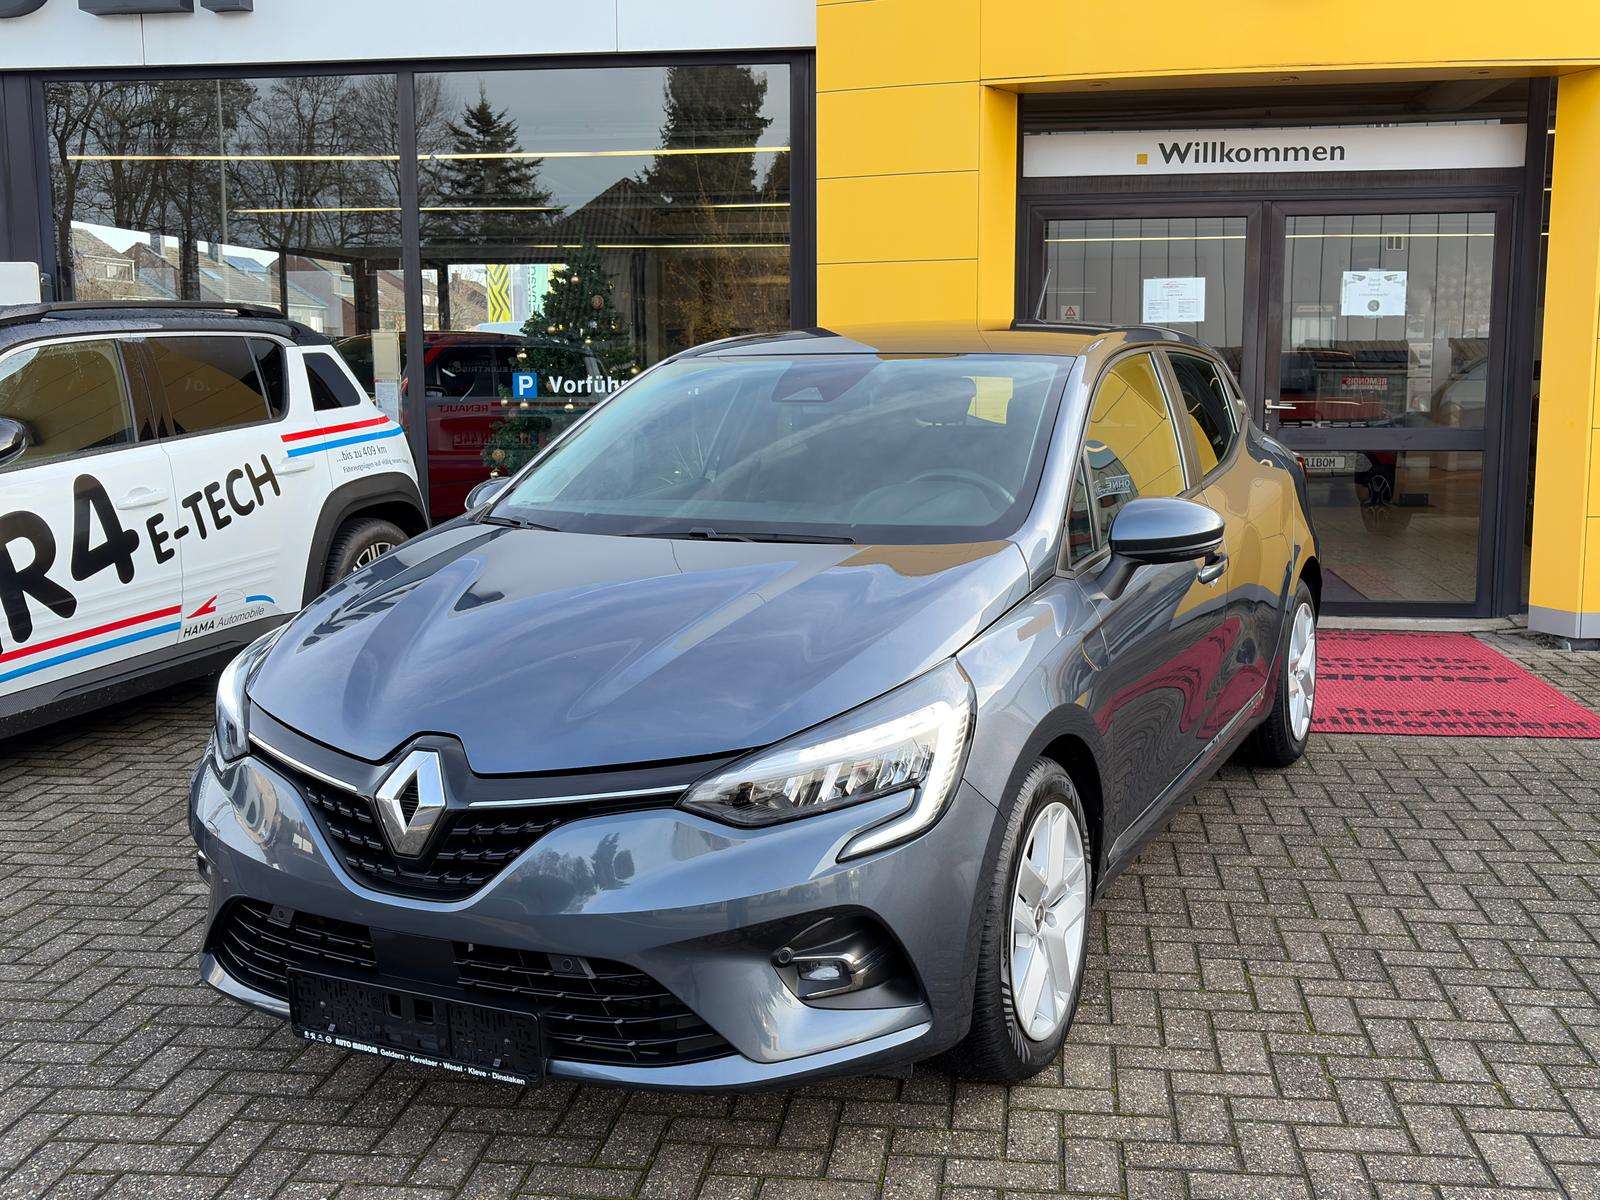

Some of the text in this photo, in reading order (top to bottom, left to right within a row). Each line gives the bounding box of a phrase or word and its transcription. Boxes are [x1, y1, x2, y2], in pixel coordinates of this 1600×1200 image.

[1158, 141, 1346, 165] Willkommen
[519, 375, 533, 396] P
[354, 450, 362, 458] zu
[363, 446, 376, 456] 409
[377, 445, 387, 454] km
[146, 453, 281, 565] E-TECH
[183, 606, 265, 638] HAMA Automobile
[1336, 707, 1519, 717] Herzlich
[380, 1048, 405, 1060] Geldern
[410, 1055, 438, 1067] Kevelaer
[444, 1062, 463, 1072] Wesel
[468, 1067, 487, 1078] Kleve
[492, 1072, 526, 1085] Dinslaken
